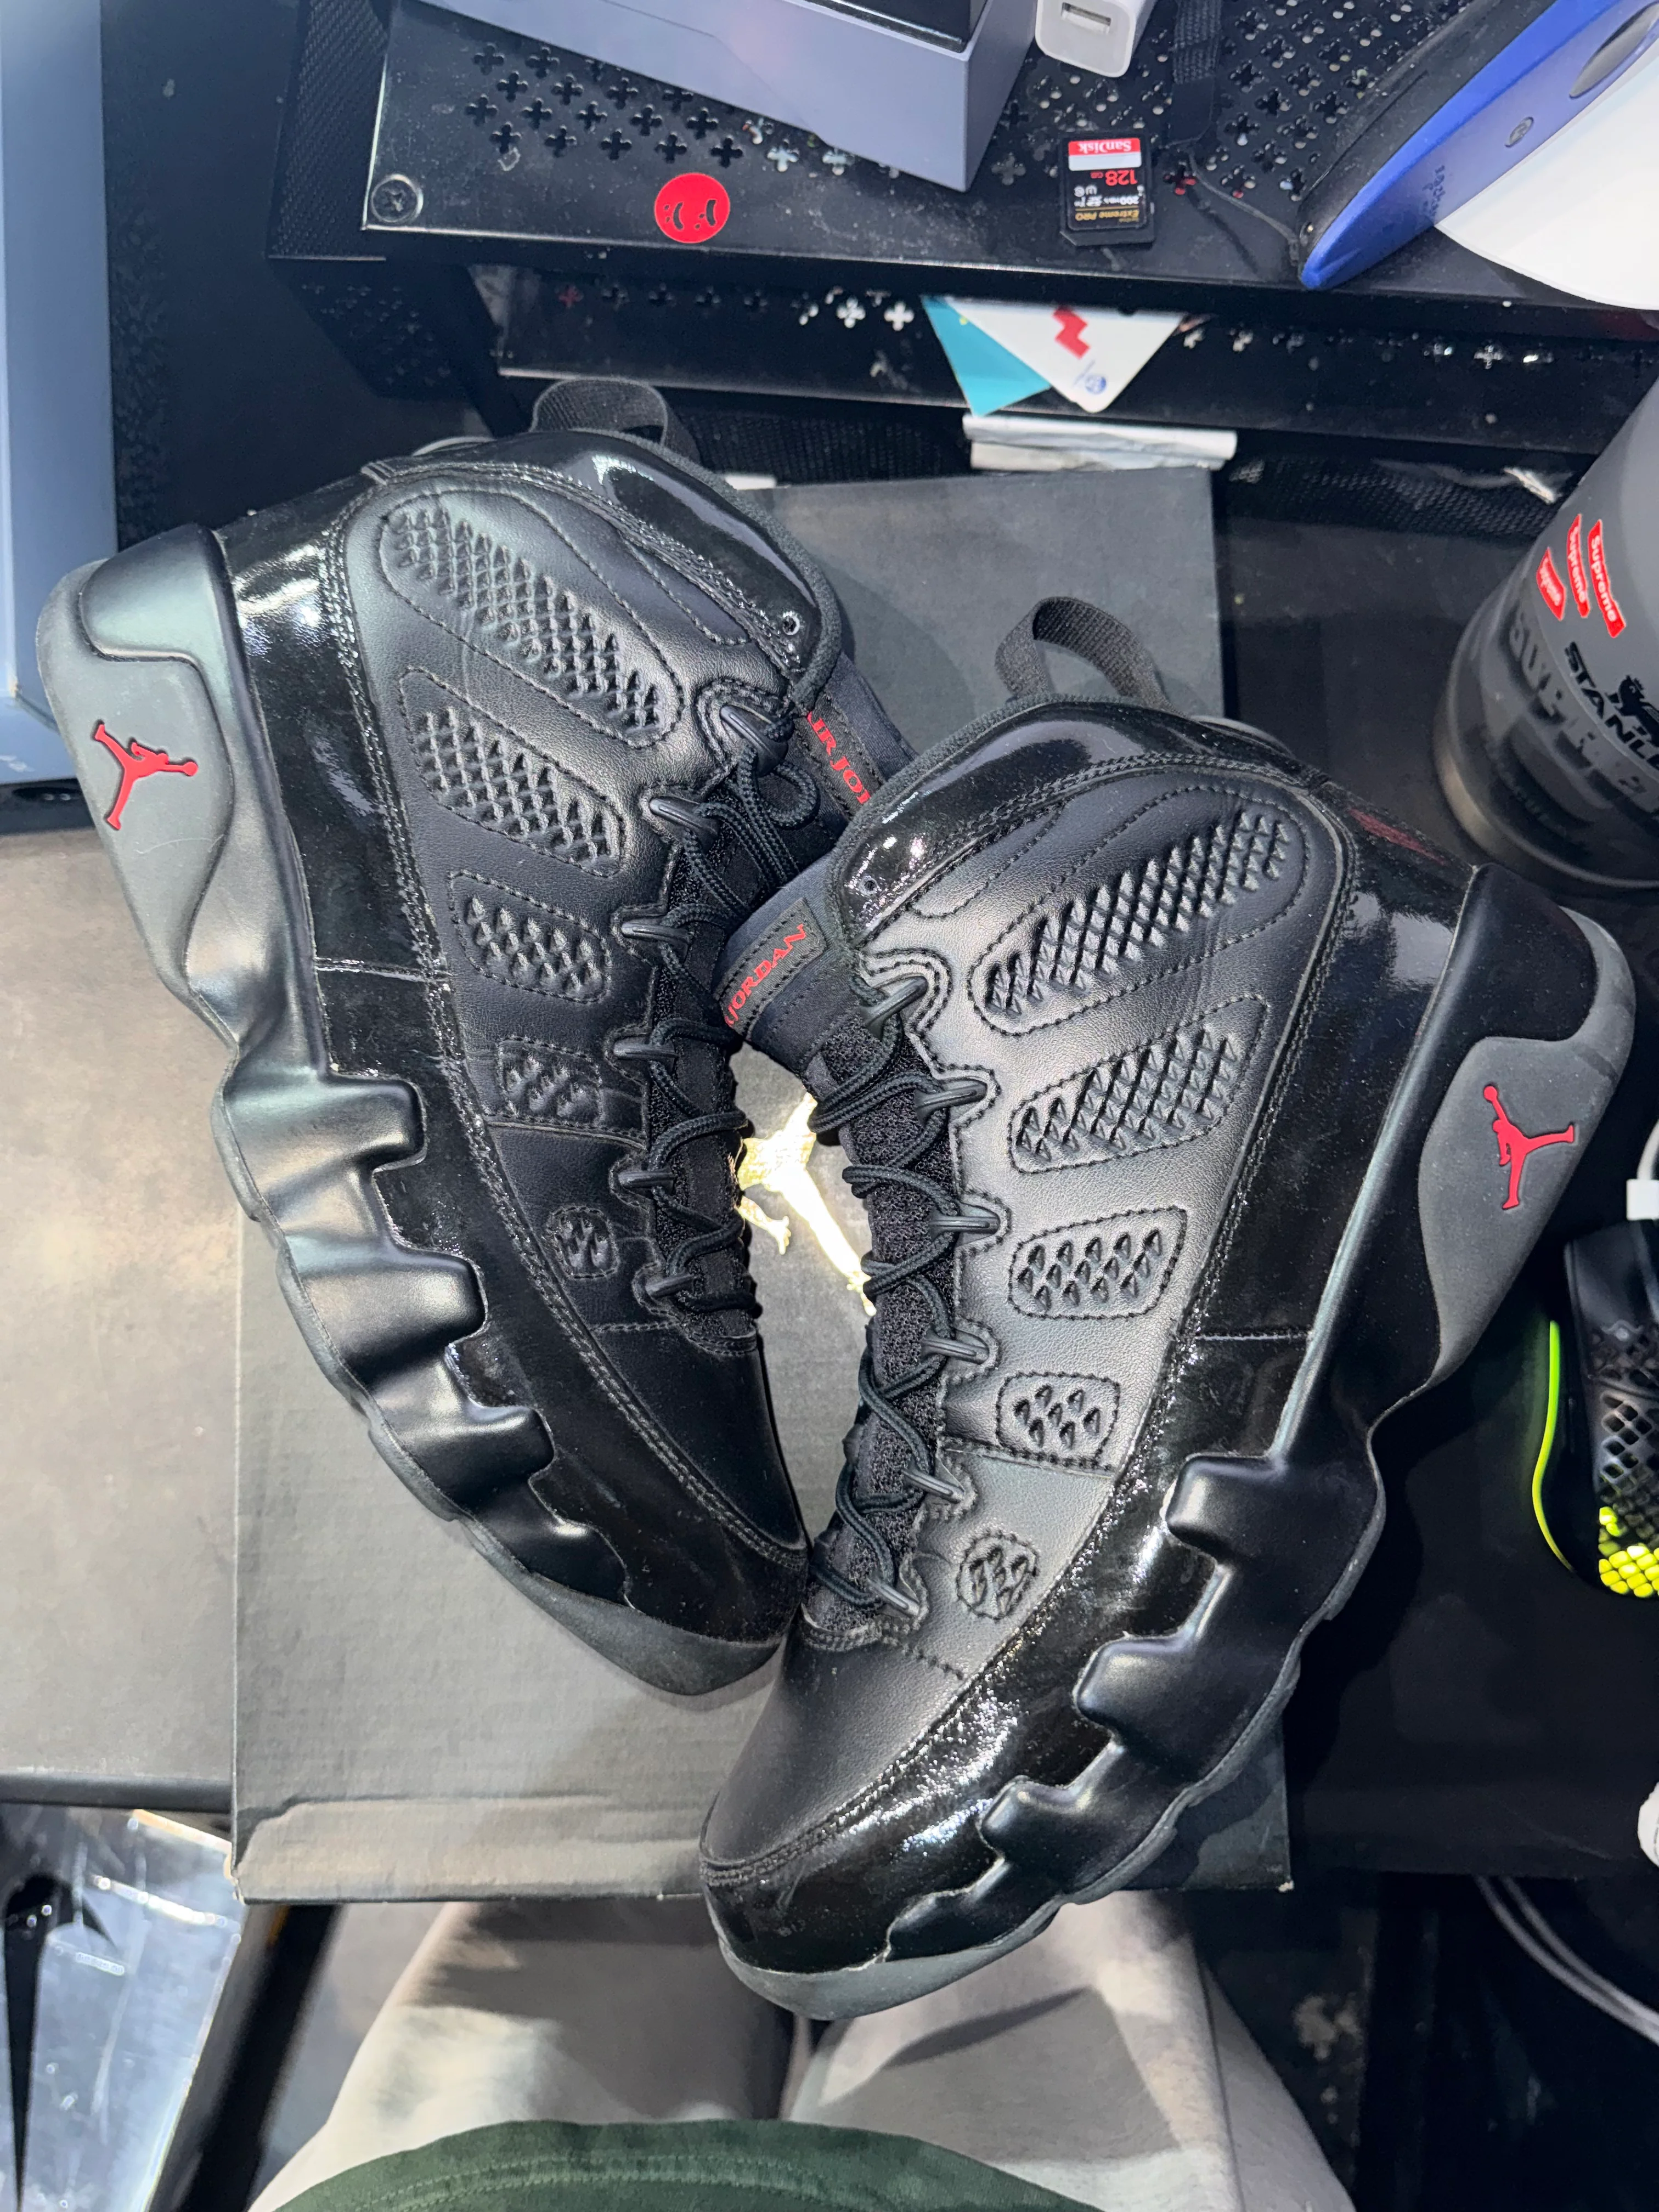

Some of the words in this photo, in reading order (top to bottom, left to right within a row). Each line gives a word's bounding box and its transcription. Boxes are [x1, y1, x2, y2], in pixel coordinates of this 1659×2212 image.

[1077, 140, 1132, 154] SanDisk
[1105, 170, 1138, 186] 128
[1075, 212, 1097, 222] PRO
[1591, 535, 1617, 622] Supreme
[728, 923, 807, 1021] JORDAN
